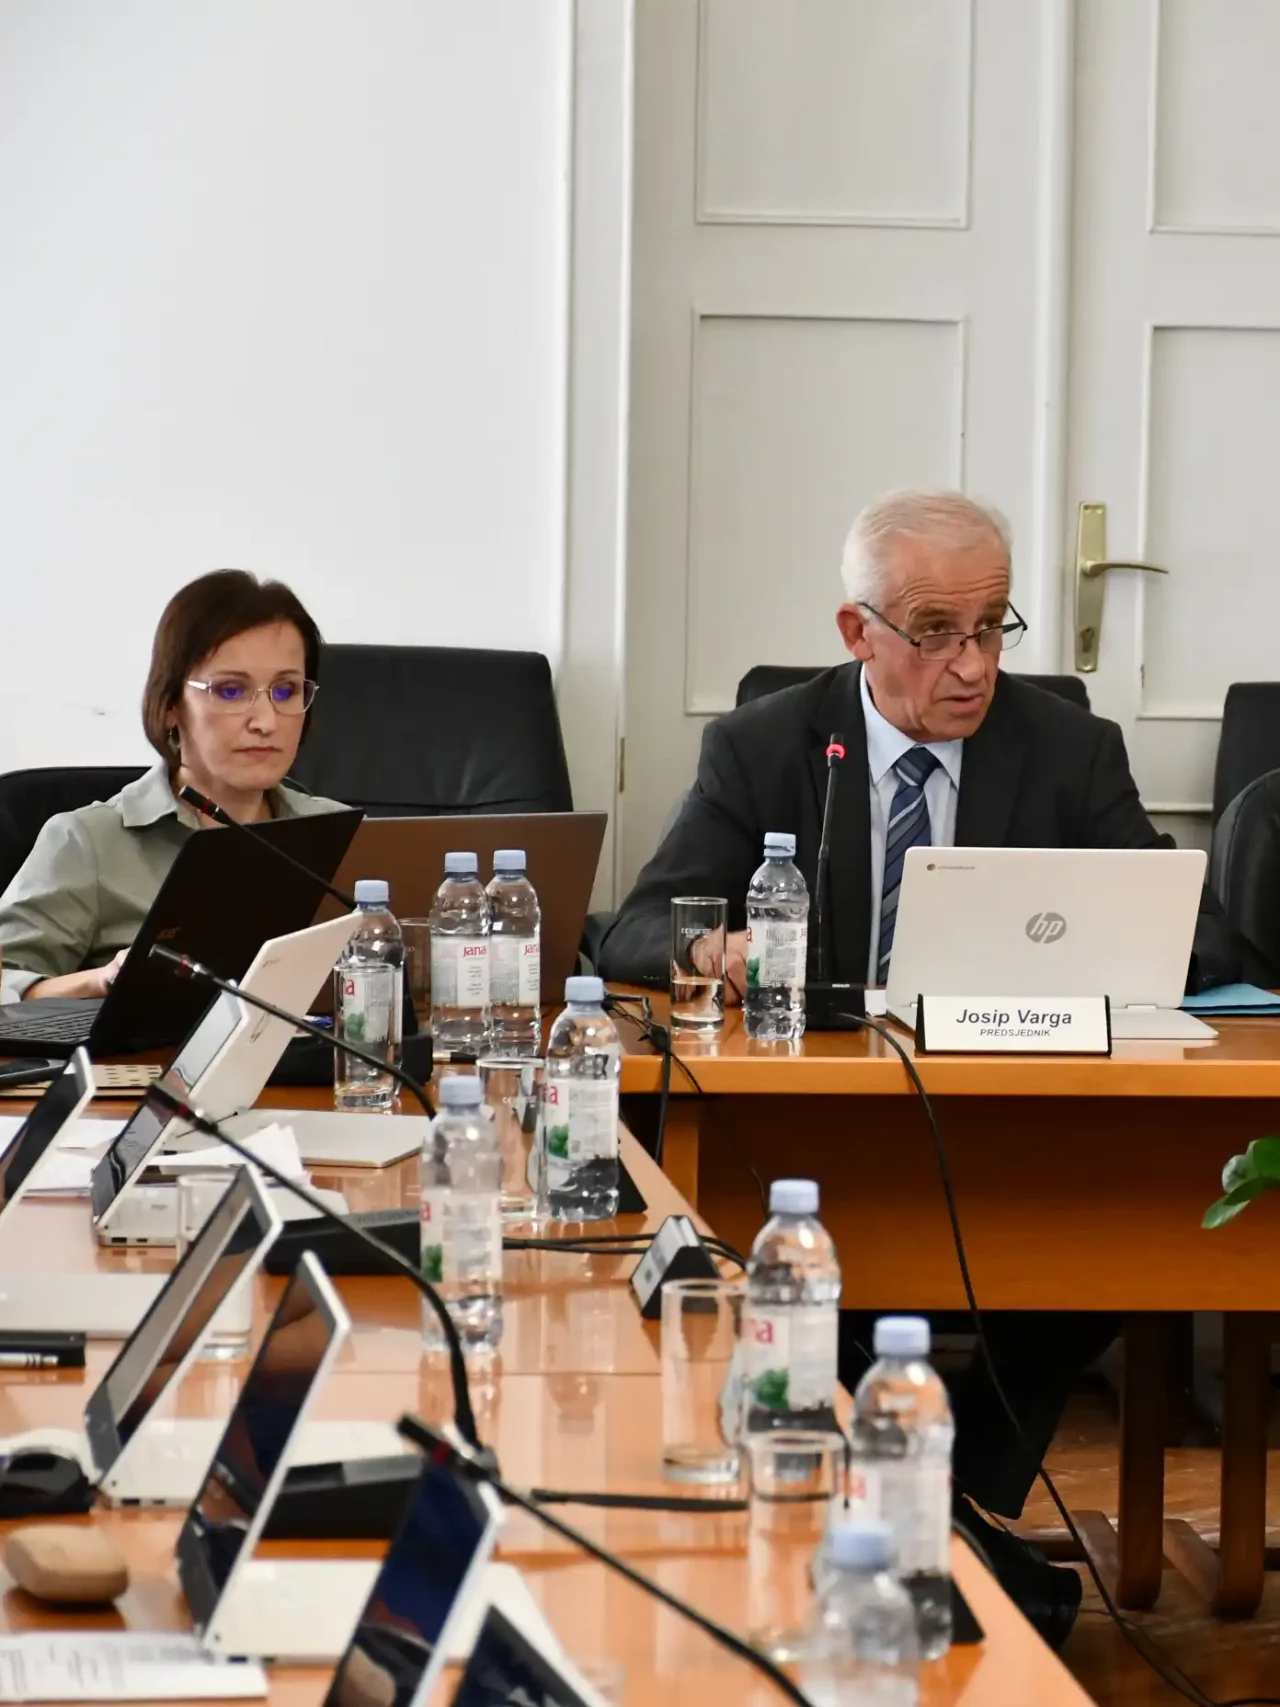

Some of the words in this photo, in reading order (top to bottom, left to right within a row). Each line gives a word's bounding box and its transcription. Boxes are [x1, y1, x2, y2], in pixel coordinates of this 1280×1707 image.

[1025, 911, 1067, 944] hp
[956, 1009, 1010, 1027] Josip
[1017, 1009, 1072, 1028] Varga
[980, 1028, 1051, 1037] PREDSJEDNIK
